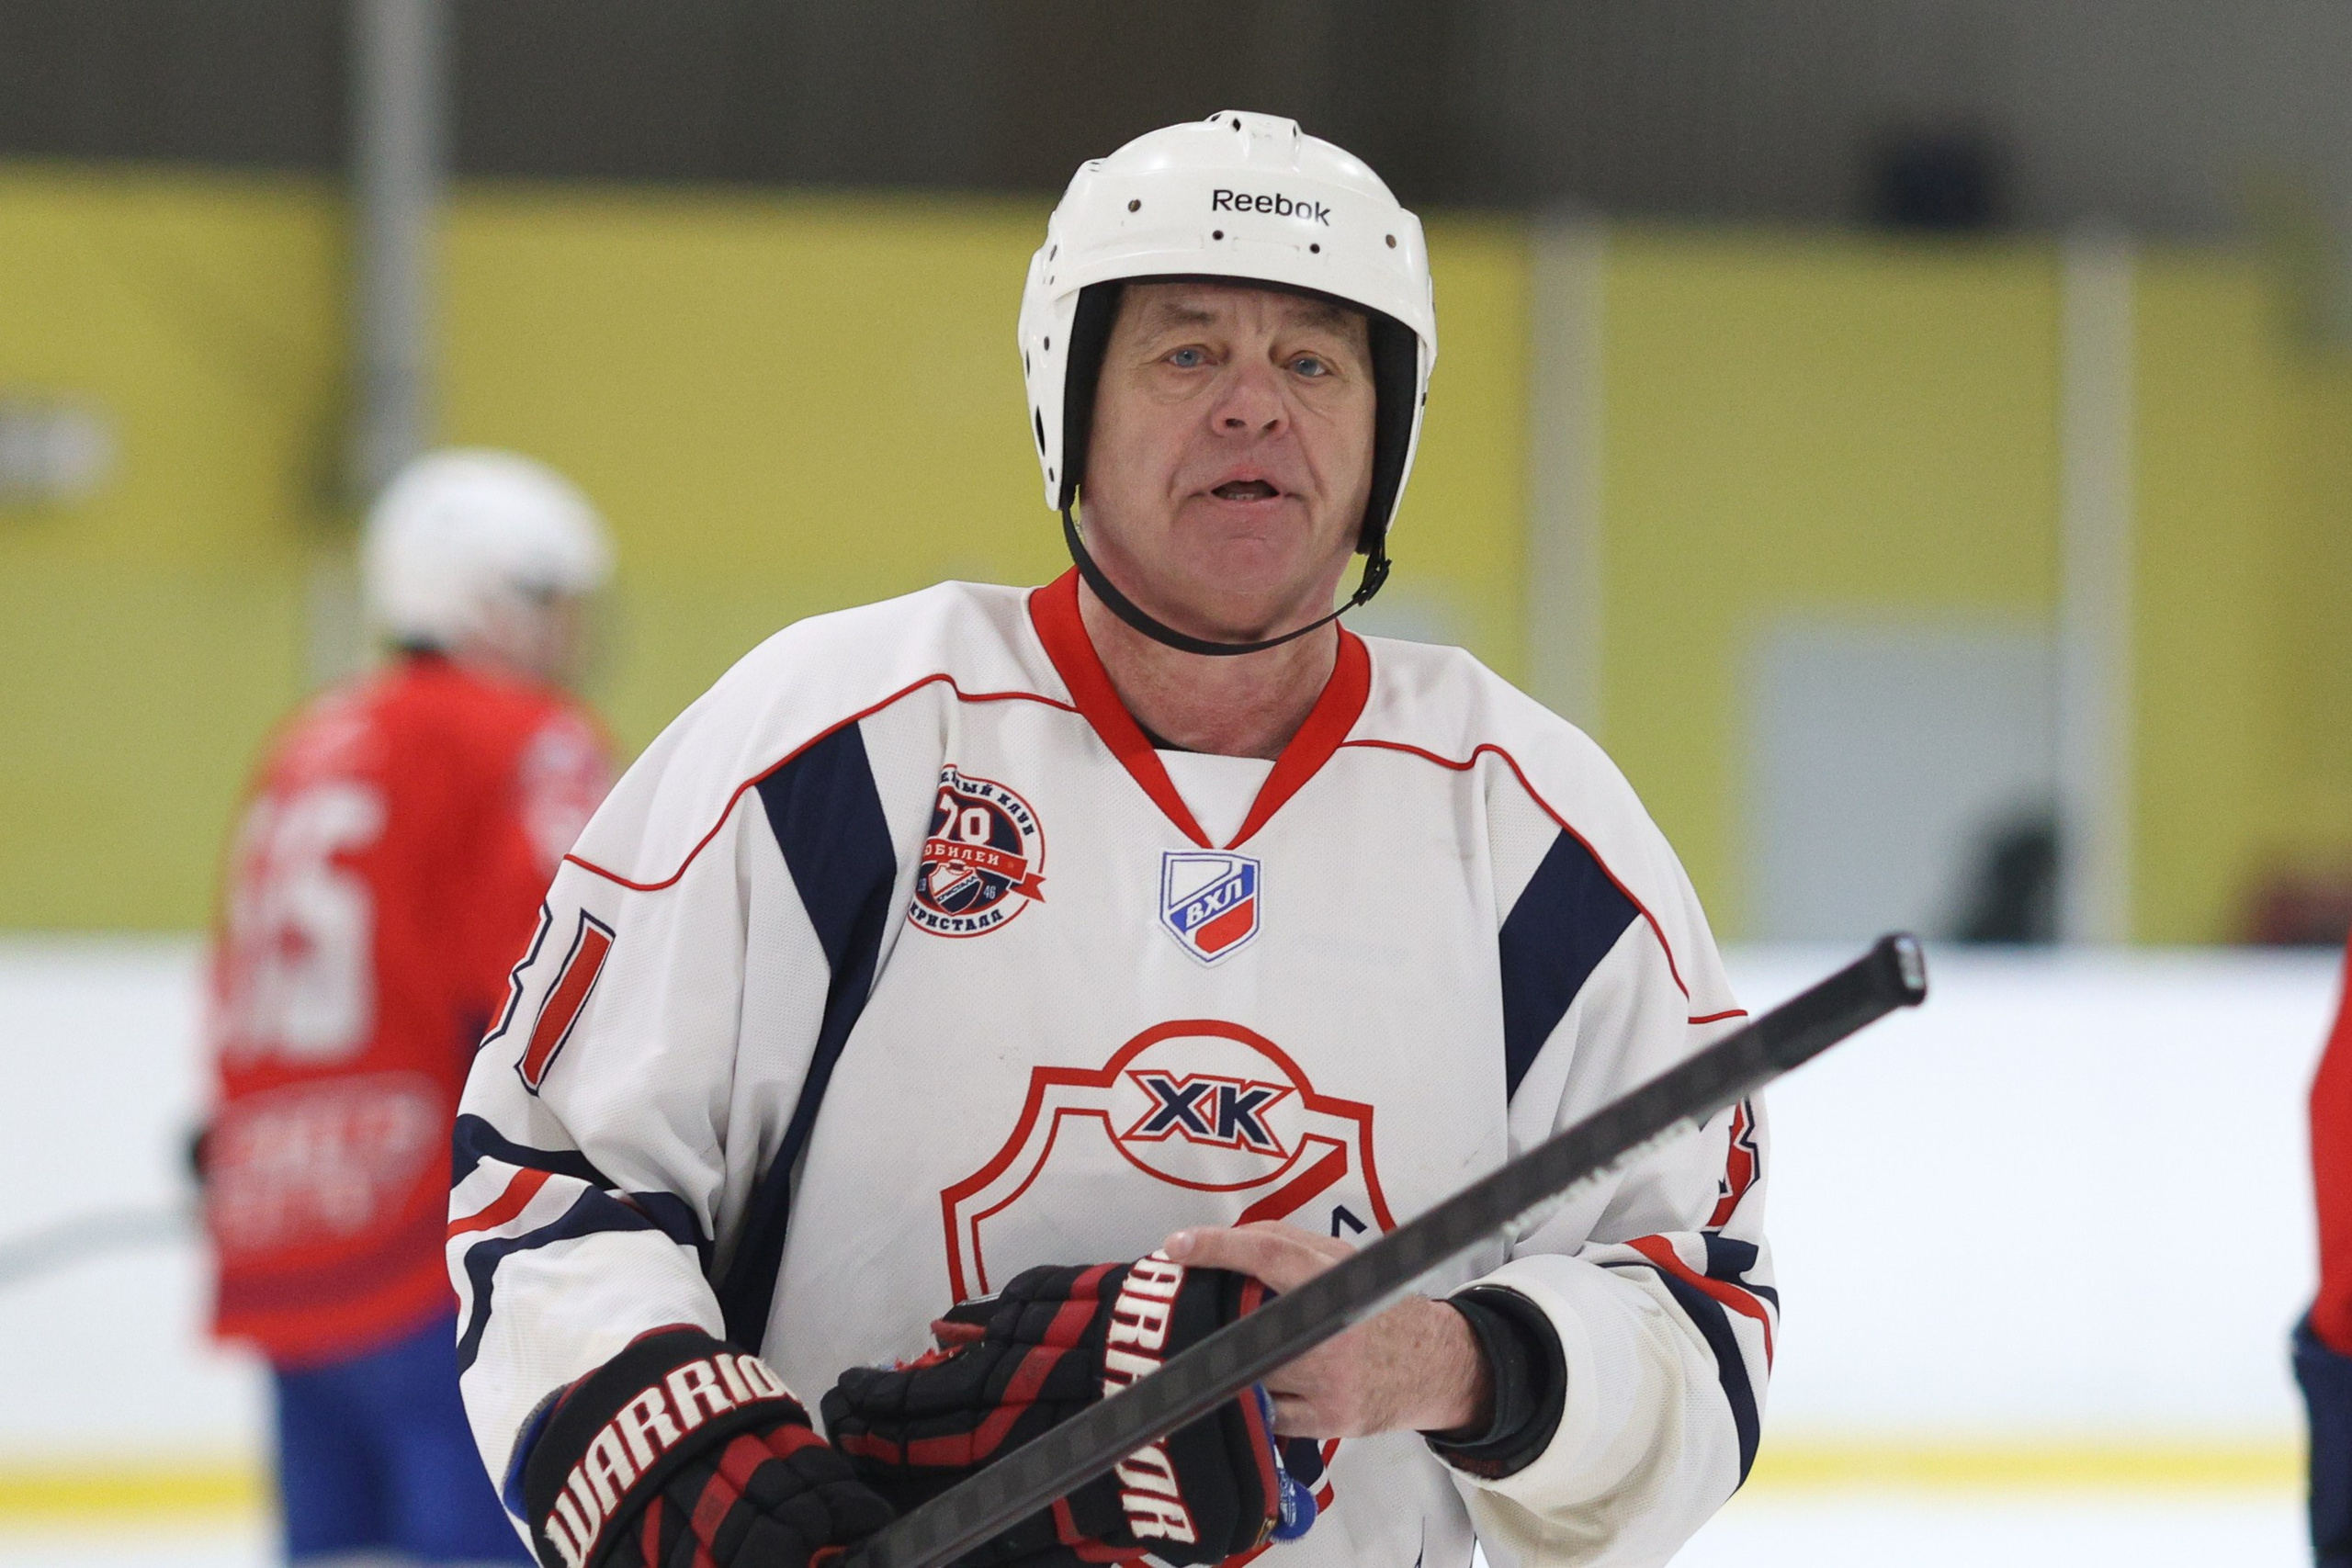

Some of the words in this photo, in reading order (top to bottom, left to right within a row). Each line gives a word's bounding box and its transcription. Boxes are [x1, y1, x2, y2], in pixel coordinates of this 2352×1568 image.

[1212, 189, 1331, 227] Reebok
[937, 793, 991, 845] 70
[983, 885, 996, 900] 46
[1185, 877, 1242, 930] ВХЛ
[1103, 1248, 1198, 1545] ARROR
[543, 1351, 803, 1568] WARRIO
